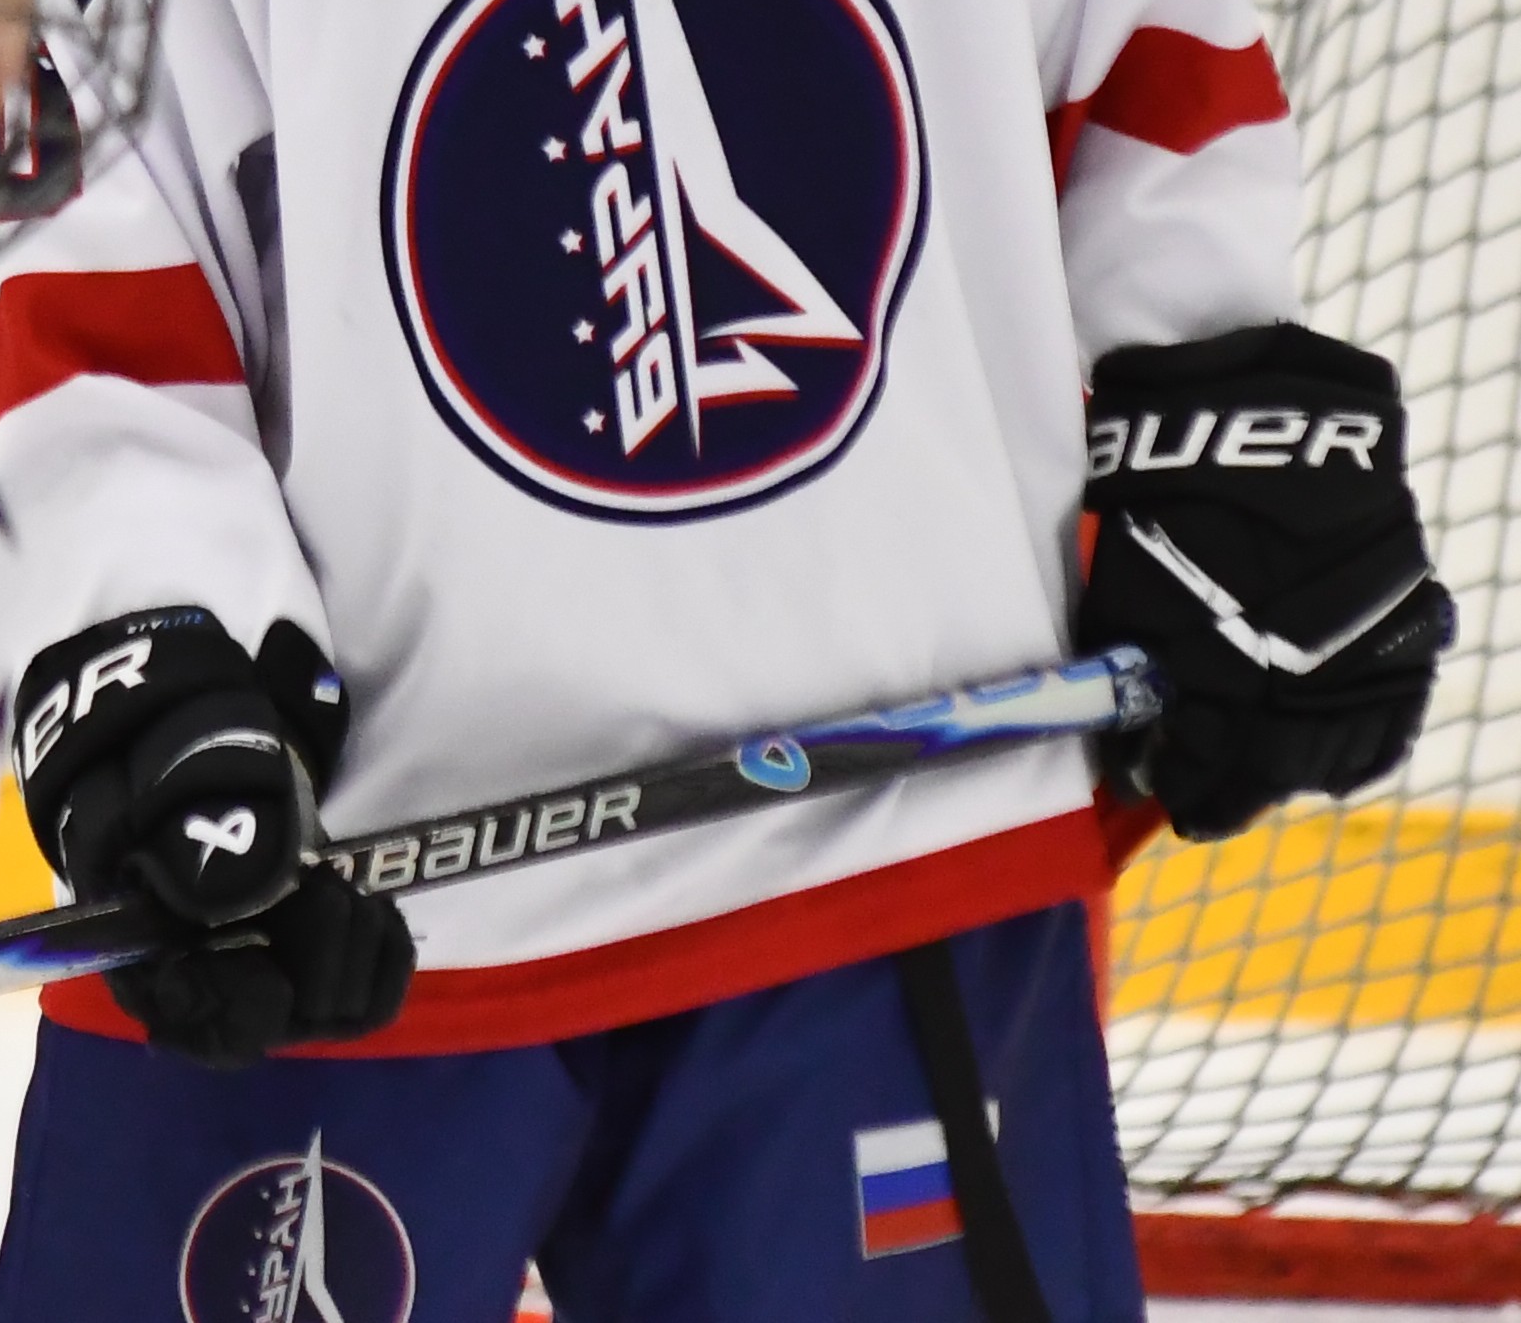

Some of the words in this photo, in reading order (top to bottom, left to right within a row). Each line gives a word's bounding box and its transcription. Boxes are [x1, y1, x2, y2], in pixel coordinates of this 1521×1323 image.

[14, 636, 152, 786] ER
[368, 784, 642, 893] BAUER
[253, 1172, 312, 1323] УРАН
